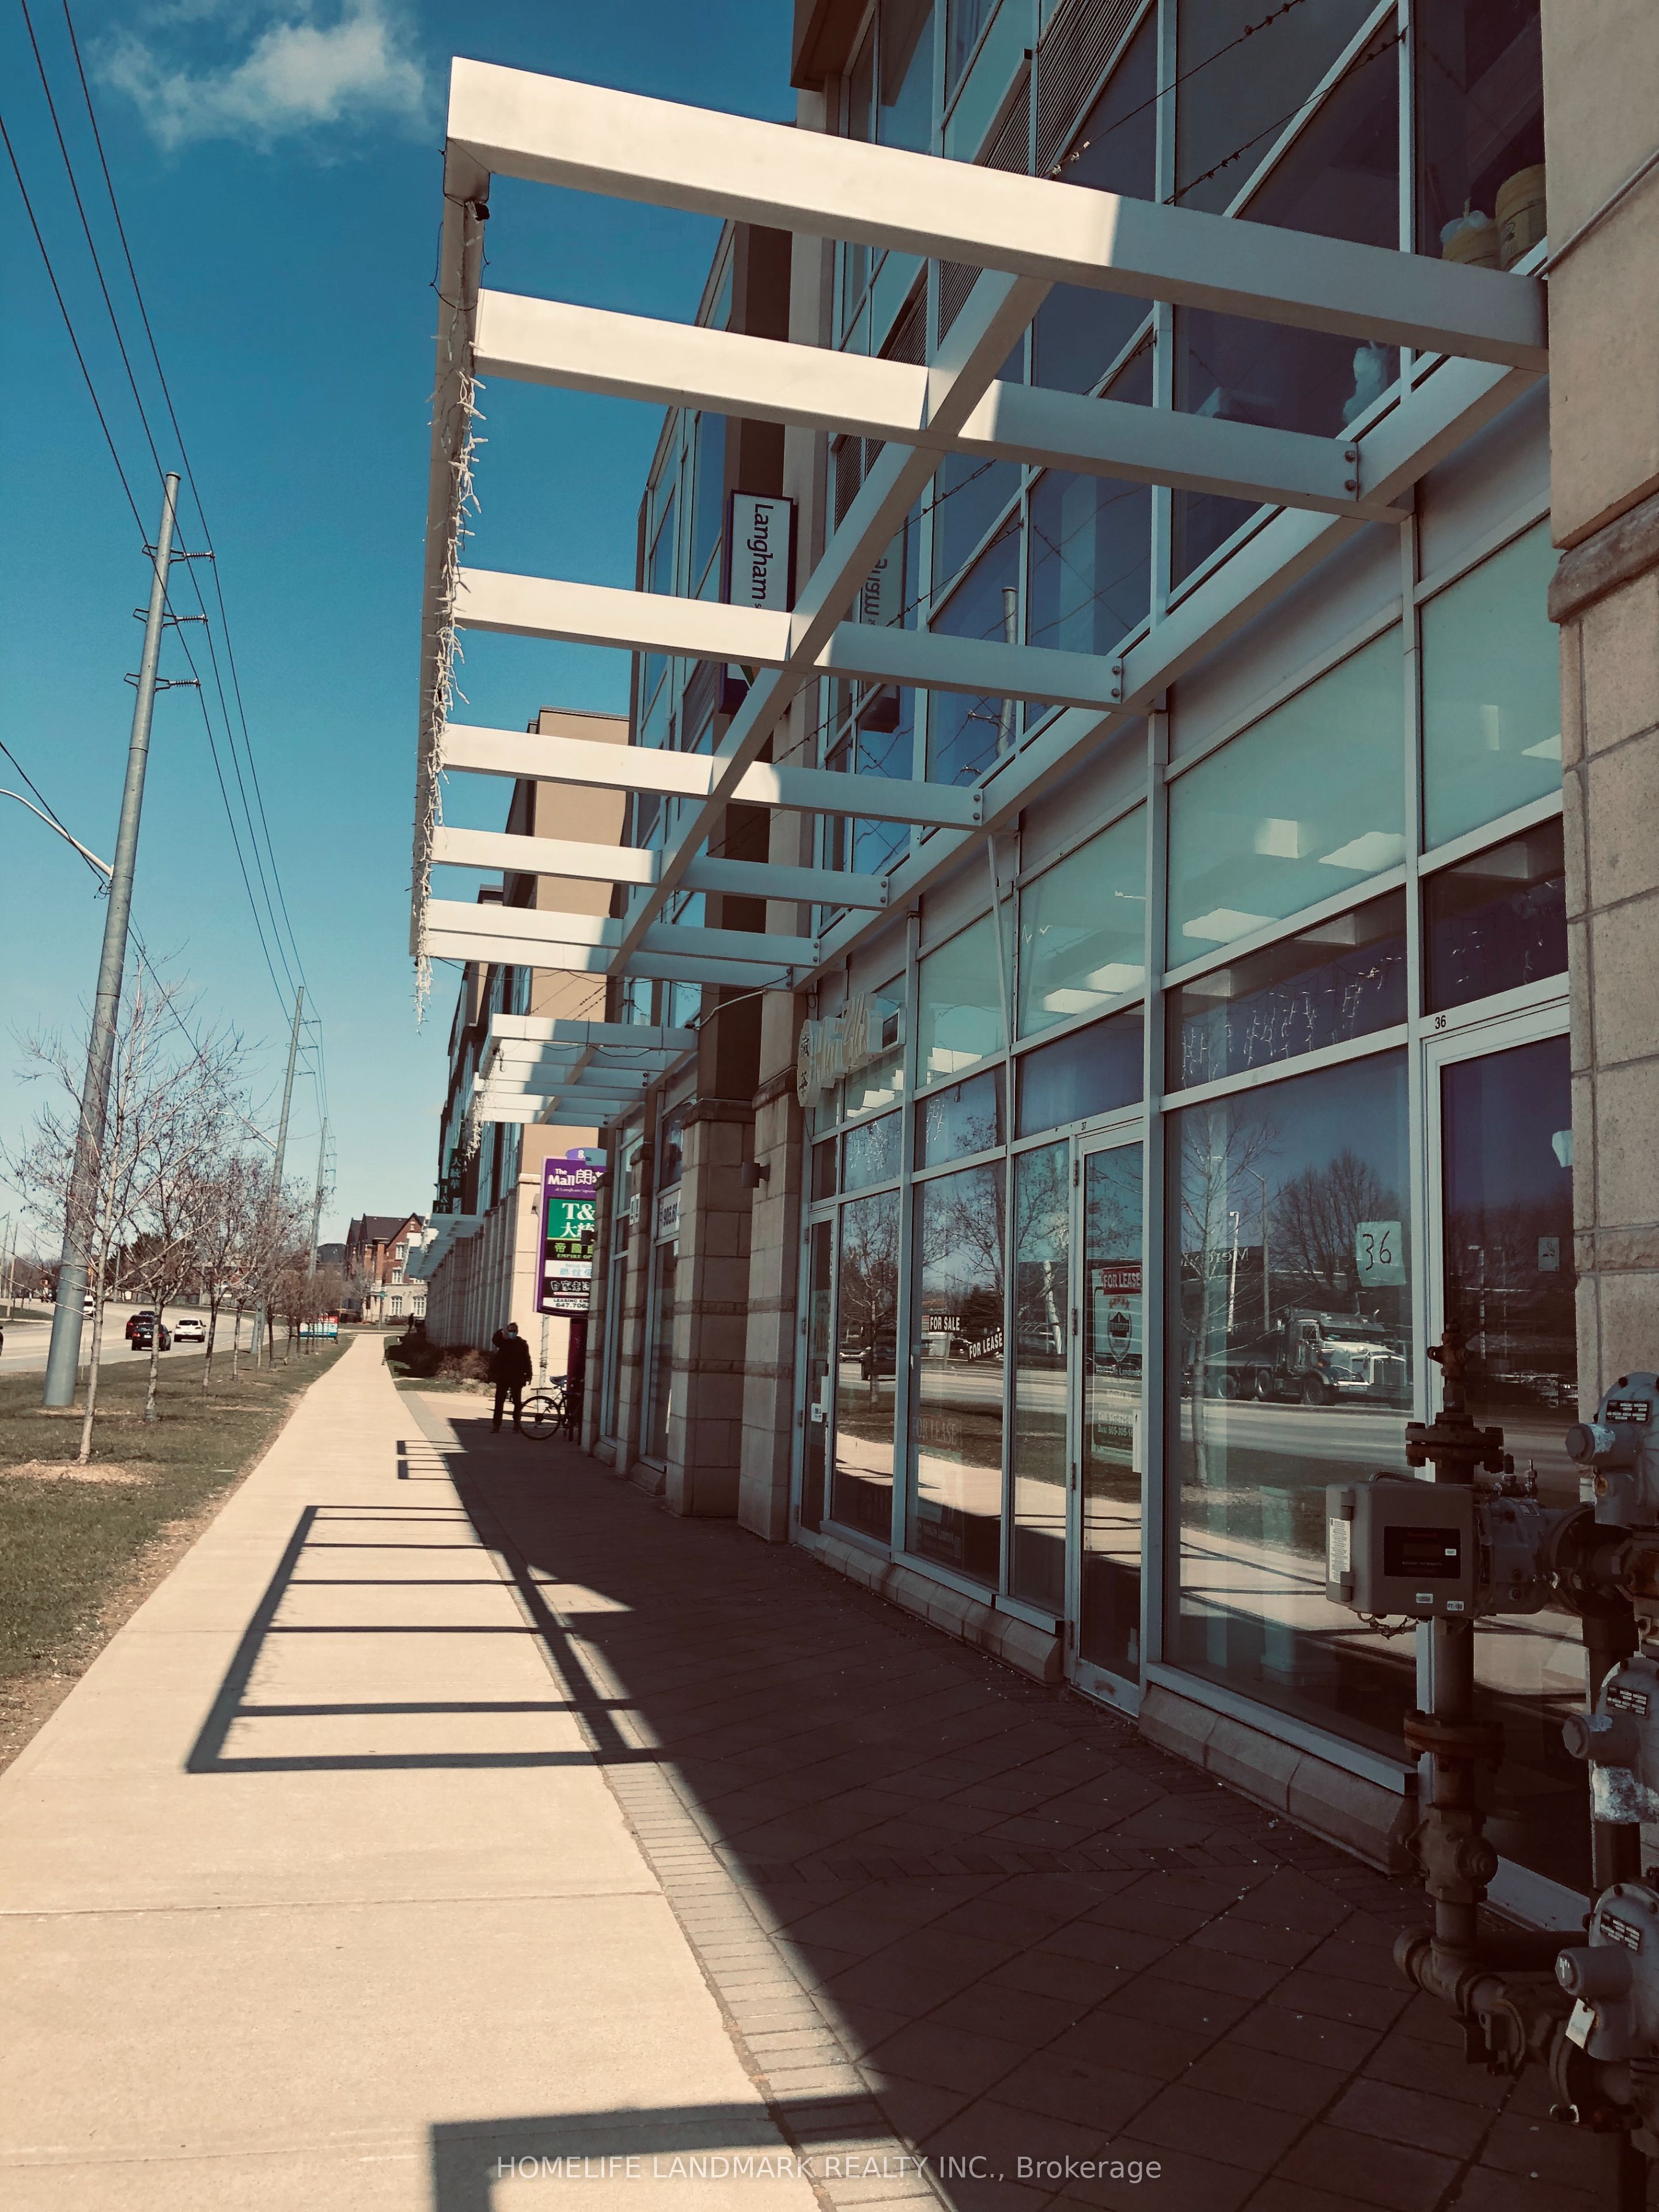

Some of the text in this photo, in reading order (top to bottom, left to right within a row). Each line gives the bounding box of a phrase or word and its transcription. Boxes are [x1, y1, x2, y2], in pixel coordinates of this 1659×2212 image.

[747, 503, 774, 600] Langham
[1435, 1014, 1446, 1029] 36
[1081, 1122, 1087, 1131] 37
[548, 1175, 575, 1186] Mall
[1362, 1230, 1392, 1271] 36
[1104, 1272, 1141, 1288] FOR LEASE
[930, 1316, 960, 1331] FOR SALE
[969, 1332, 1002, 1359] FOR LEASE
[912, 1417, 956, 1445] FOR LEASE
